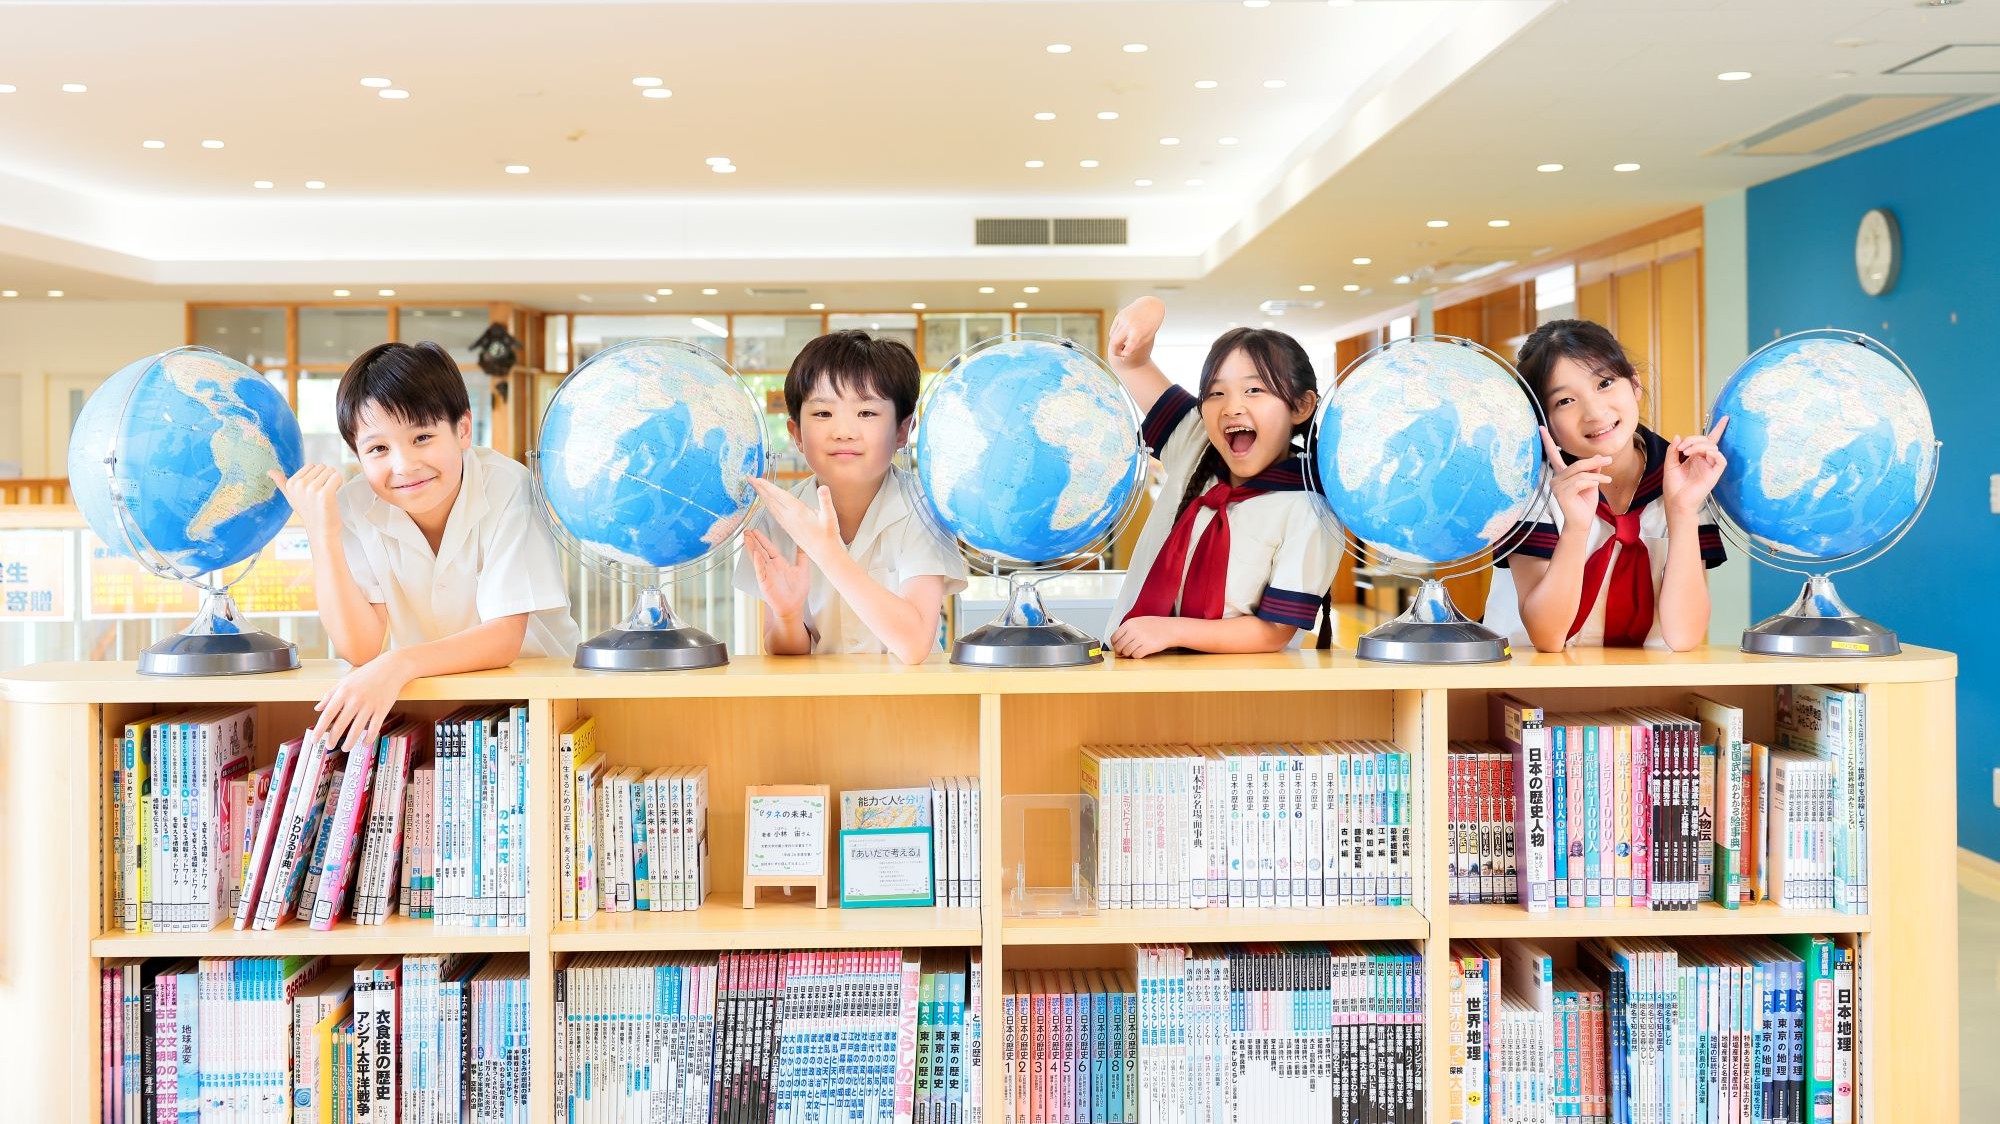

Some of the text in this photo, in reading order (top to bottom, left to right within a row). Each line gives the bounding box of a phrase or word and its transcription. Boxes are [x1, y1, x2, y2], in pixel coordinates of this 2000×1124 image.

[0, 562, 29, 583] 生
[6, 591, 52, 612] 寄贈
[1260, 760, 1272, 771] Jr.
[1275, 760, 1288, 771] Jr.
[1292, 760, 1304, 771] Jr.
[1528, 748, 1544, 847] 日本の歴史人物
[1555, 751, 1565, 819] 日本史1000人
[1569, 752, 1582, 840] 戦国1000人
[1634, 752, 1646, 842] 源平1000人
[498, 810, 509, 865] の大研究
[647, 784, 655, 826] タネの未来
[658, 784, 667, 826] タネの未来
[671, 784, 680, 826] タネの未来
[686, 784, 694, 826] タネの未来
[760, 809, 813, 819] 『タネの未来』
[1193, 765, 1202, 848] 日本史の名場面事典
[852, 848, 921, 858] 『あいだで考える』
[182, 1024, 192, 1064] 地球激変
[1005, 996, 1014, 1073] 読む日本の歴史 1
[1019, 996, 1028, 1073] 読む日本の歴史 2
[1079, 996, 1088, 1073] 読む日本の歴史 6
[1096, 996, 1106, 1073] 読む日本の歴史 7
[1112, 996, 1121, 1073] 読む日本の歴史 8
[1126, 996, 1136, 1072] 読む日本の歴史 9
[1467, 997, 1481, 1061] 世界地理
[1762, 1020, 1773, 1078] 東京の地理
[1776, 1019, 1788, 1076] 東京の地理
[1793, 1018, 1804, 1076] 東京の地理
[1837, 989, 1852, 1052] 日本地理
[156, 1008, 166, 1118] 古代文明の大研究
[167, 1008, 178, 1118] 古代文明の大研究
[356, 1011, 371, 1116] アジア・太平洋戦争
[376, 1009, 391, 1101] 衣食住の歴史
[776, 1034, 788, 1110] 大むかしの日本
[784, 1034, 795, 1110] 大むかしの日本
[793, 1034, 803, 1099] 貴族の世の中
[800, 1034, 810, 1099] 貴族の世の中
[805, 1034, 817, 1120] 武士の政治と文化
[812, 1034, 824, 1120] 武士の政治と文化
[820, 1033, 831, 1106] 戦乱と天下統一
[829, 1033, 839, 1106] 戦乱と天下統一
[837, 1032, 847, 1108] 江戸幕府の成立
[844, 1032, 855, 1108] 江戸幕府の成立
[850, 1032, 861, 1118] 社会の変化と開国
[857, 1032, 868, 1118] 社会の変化と開国
[865, 1032, 875, 1097] 近代の幕あけ
[880, 1032, 890, 1118] 激動の昭和と現代
[887, 1032, 897, 1118] 激動の昭和と現代
[918, 1030, 930, 1090] 東京の歴史
[934, 1030, 946, 1089] 東京の歴史
[949, 1031, 961, 1089] 東京の歴史
[1035, 1061, 1042, 1073] 3
[1050, 1061, 1057, 1073] 4
[1063, 1061, 1070, 1073] 5
